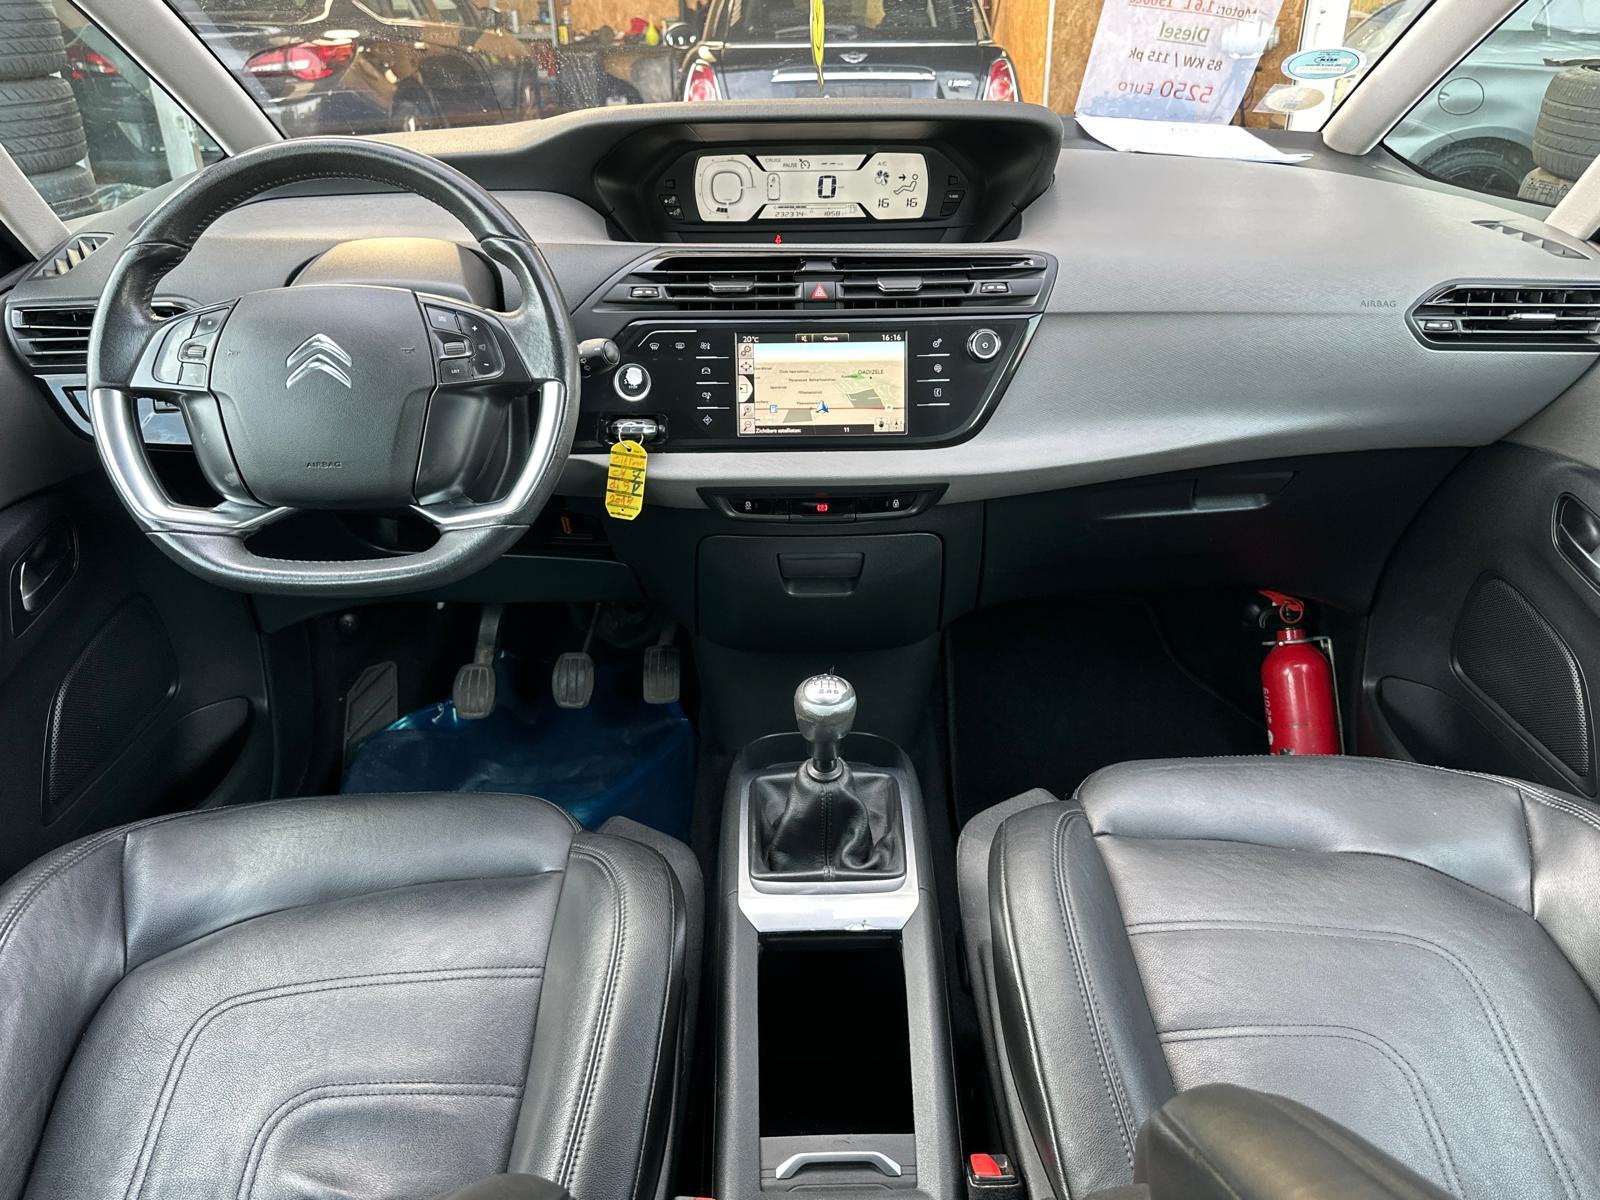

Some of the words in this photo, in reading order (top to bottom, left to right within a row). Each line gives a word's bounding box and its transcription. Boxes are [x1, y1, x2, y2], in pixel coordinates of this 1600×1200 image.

[817, 175, 837, 198] 0
[877, 198, 890, 208] 16
[906, 197, 918, 208] 16
[1360, 299, 1397, 308] AIRBAG
[742, 335, 760, 343] 20°C
[306, 461, 342, 469] AIRBAG
